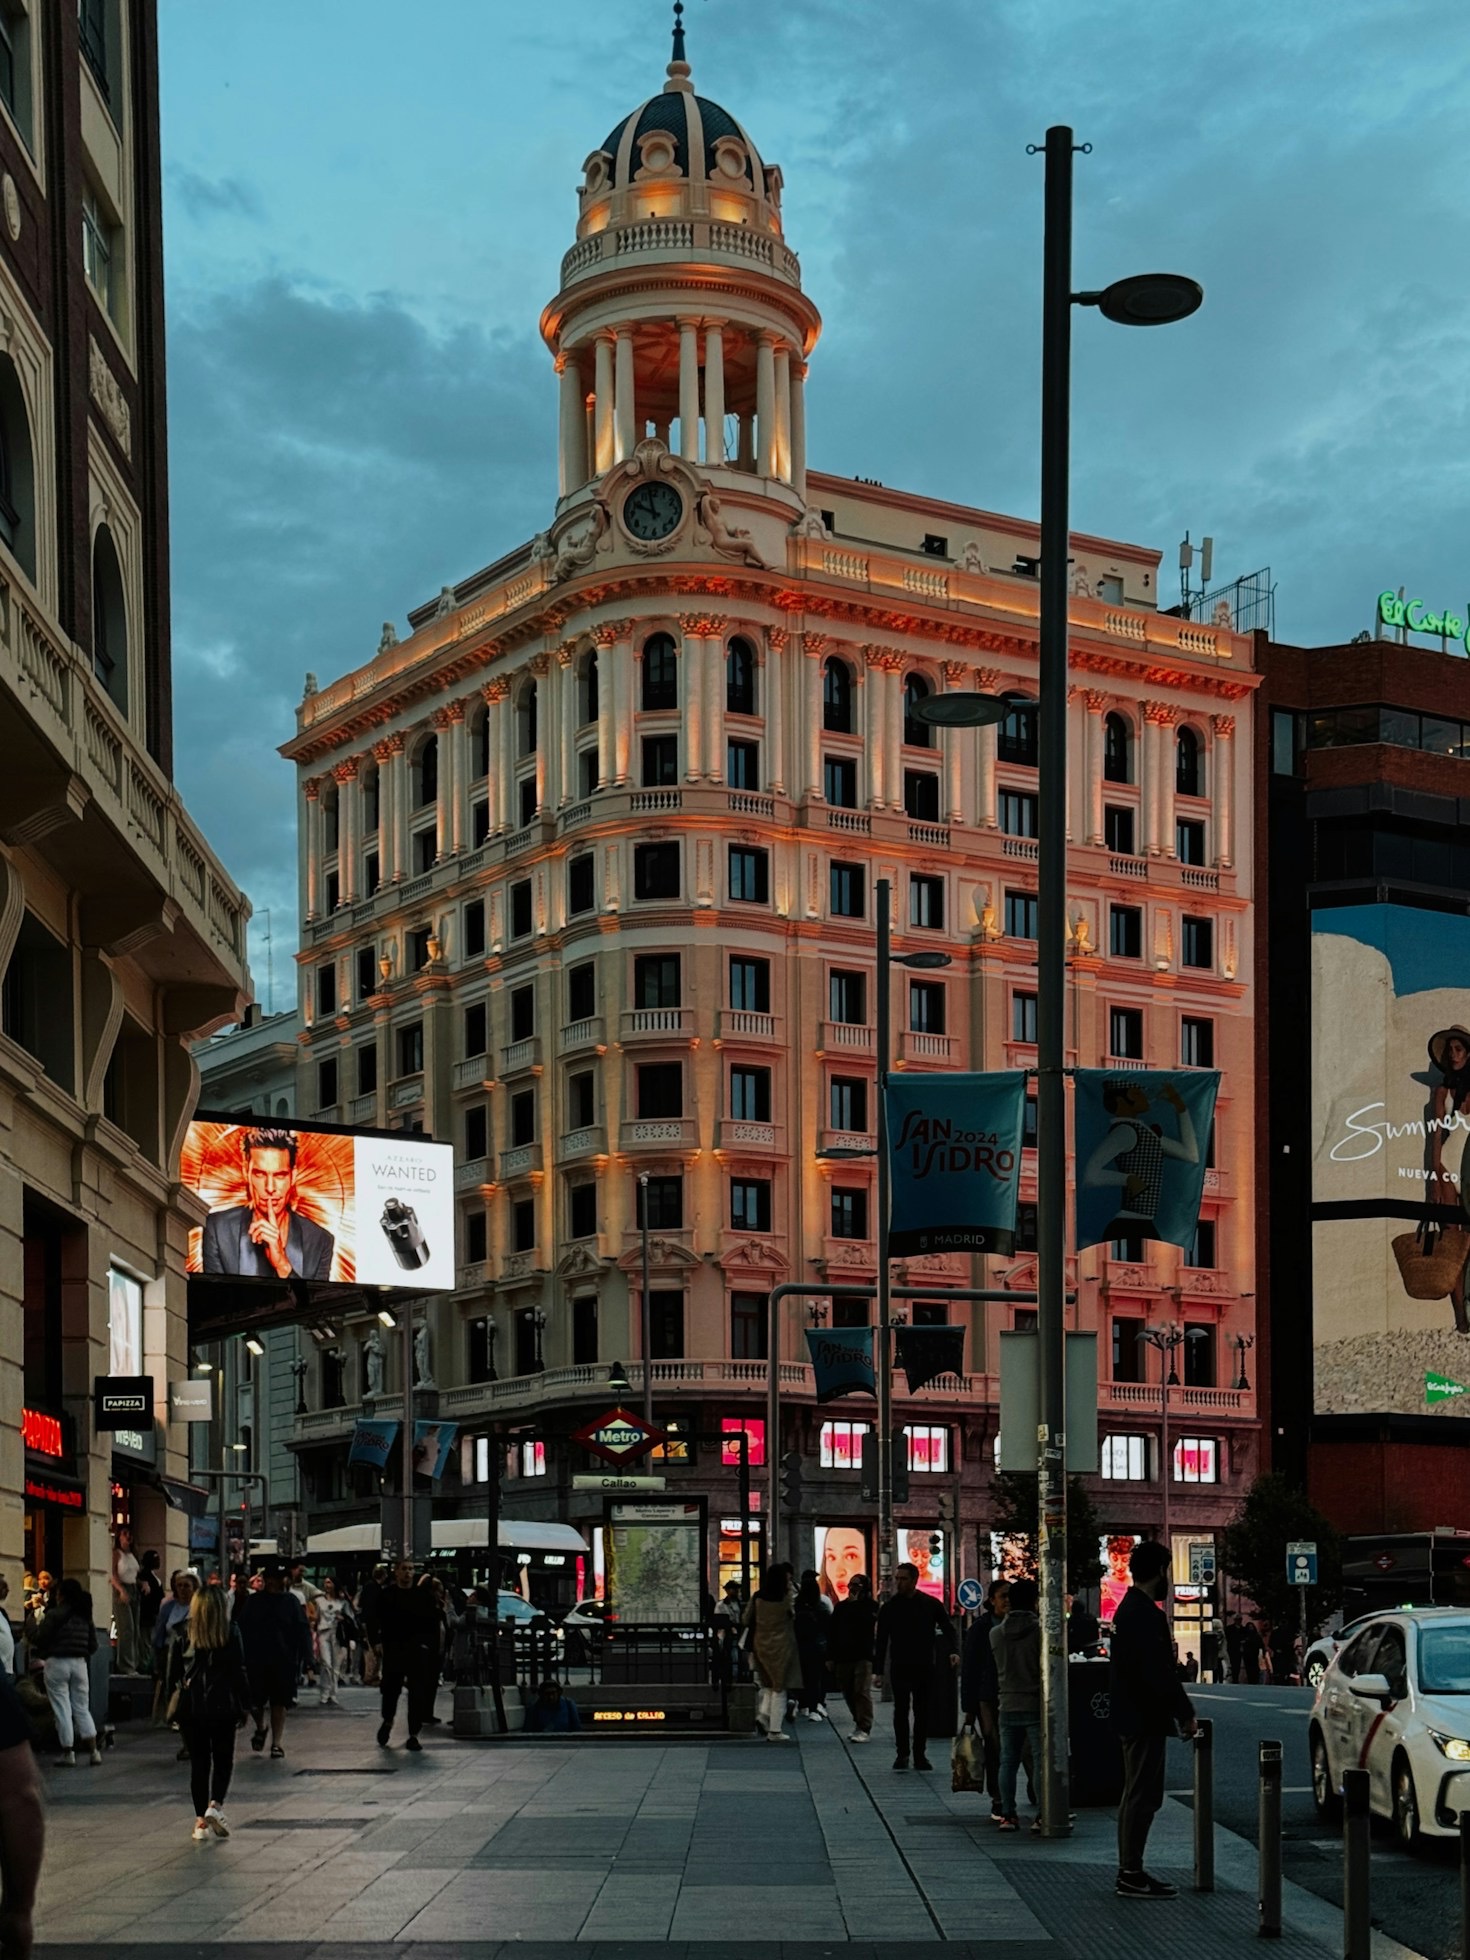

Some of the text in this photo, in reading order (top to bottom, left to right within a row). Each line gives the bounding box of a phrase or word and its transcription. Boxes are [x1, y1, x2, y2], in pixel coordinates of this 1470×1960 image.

[1405, 599, 1462, 638] Corte
[896, 1109, 998, 1151] SAN 2024
[913, 1141, 1015, 1182] ISIDRO
[372, 1163, 436, 1182] WANTED
[1398, 1167, 1438, 1181] NUEVA
[934, 1233, 986, 1246] MADRID
[107, 1399, 141, 1408] PAPIZZA
[599, 1430, 641, 1443] Metro
[602, 1478, 637, 1488] Callao
